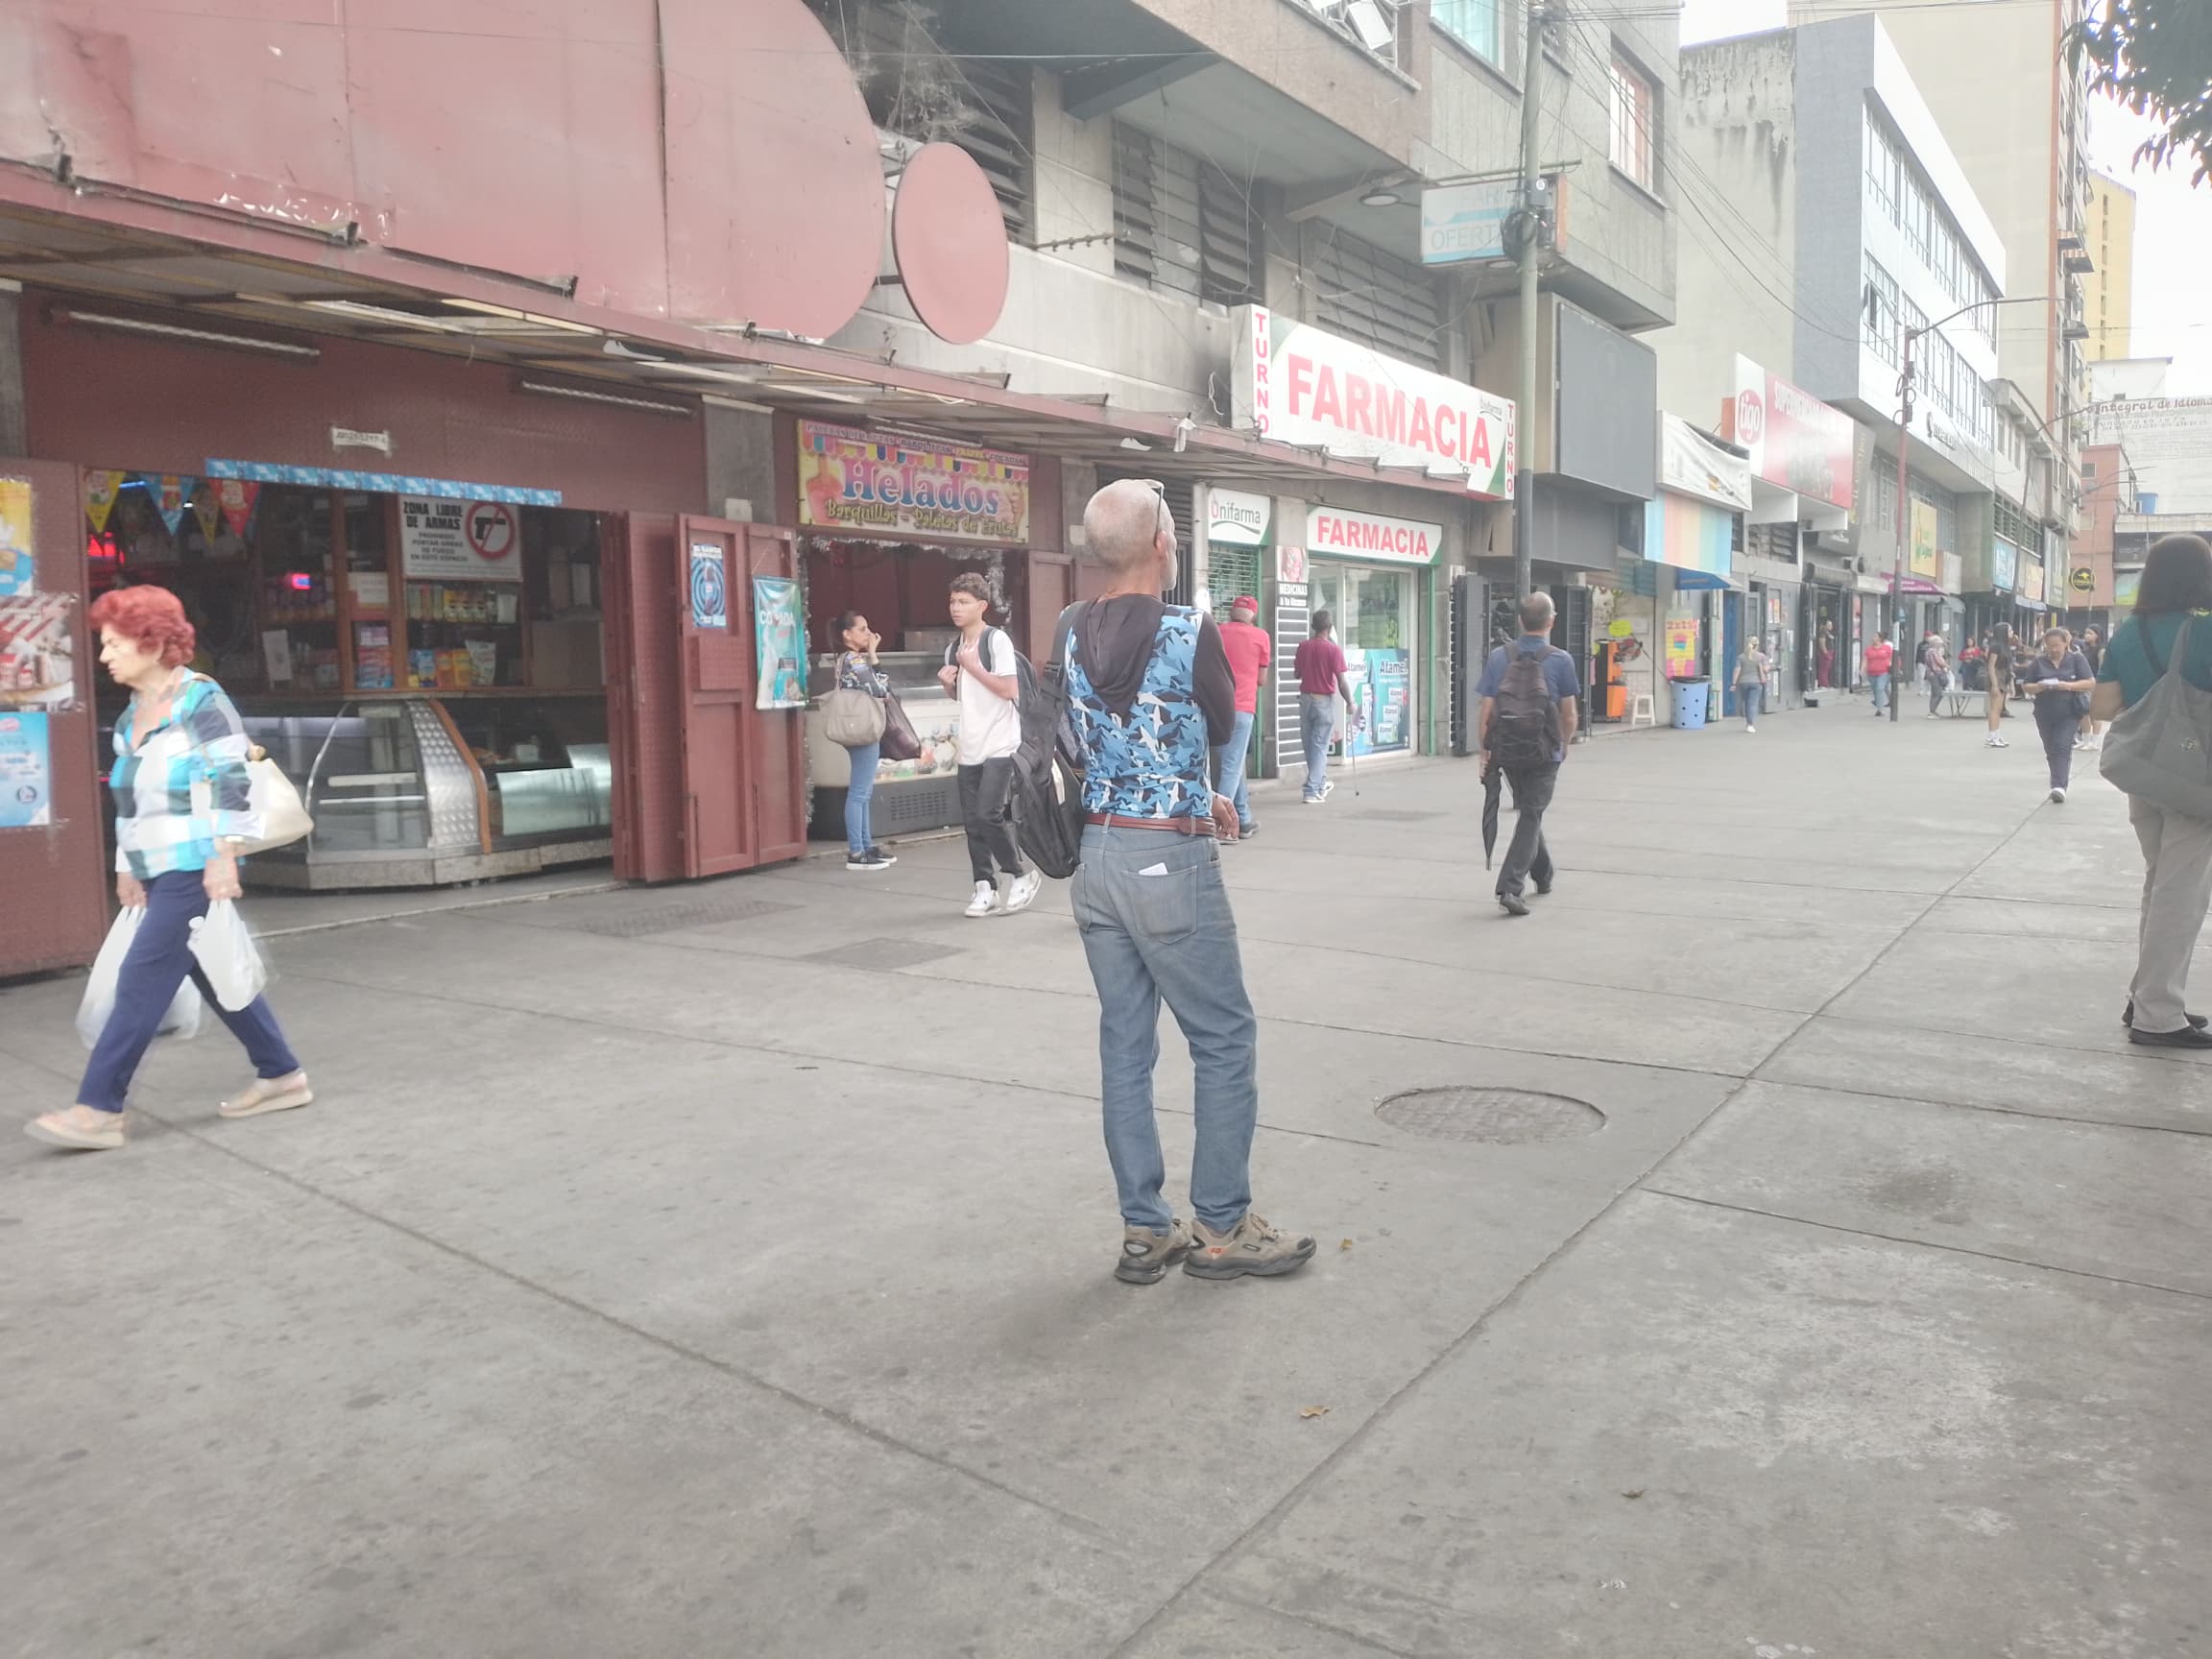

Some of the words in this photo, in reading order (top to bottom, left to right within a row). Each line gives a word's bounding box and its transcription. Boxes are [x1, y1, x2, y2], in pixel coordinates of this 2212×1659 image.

[1431, 223, 1502, 250] OFERT
[1255, 313, 1270, 433] TURNO
[1287, 353, 1492, 469] FARMACIA
[2095, 399, 2154, 415] Integral
[2157, 399, 2170, 409] de
[842, 459, 999, 517] Helados
[403, 501, 430, 516] ZONA
[436, 503, 464, 518] LIBRE
[406, 515, 419, 529] DE
[425, 517, 461, 531] ARMAS
[827, 498, 898, 526] Barquillas
[914, 507, 959, 532] Paletas
[961, 514, 978, 534] de
[1212, 493, 1261, 524] Unifarma
[1317, 516, 1430, 557] FARMACIA
